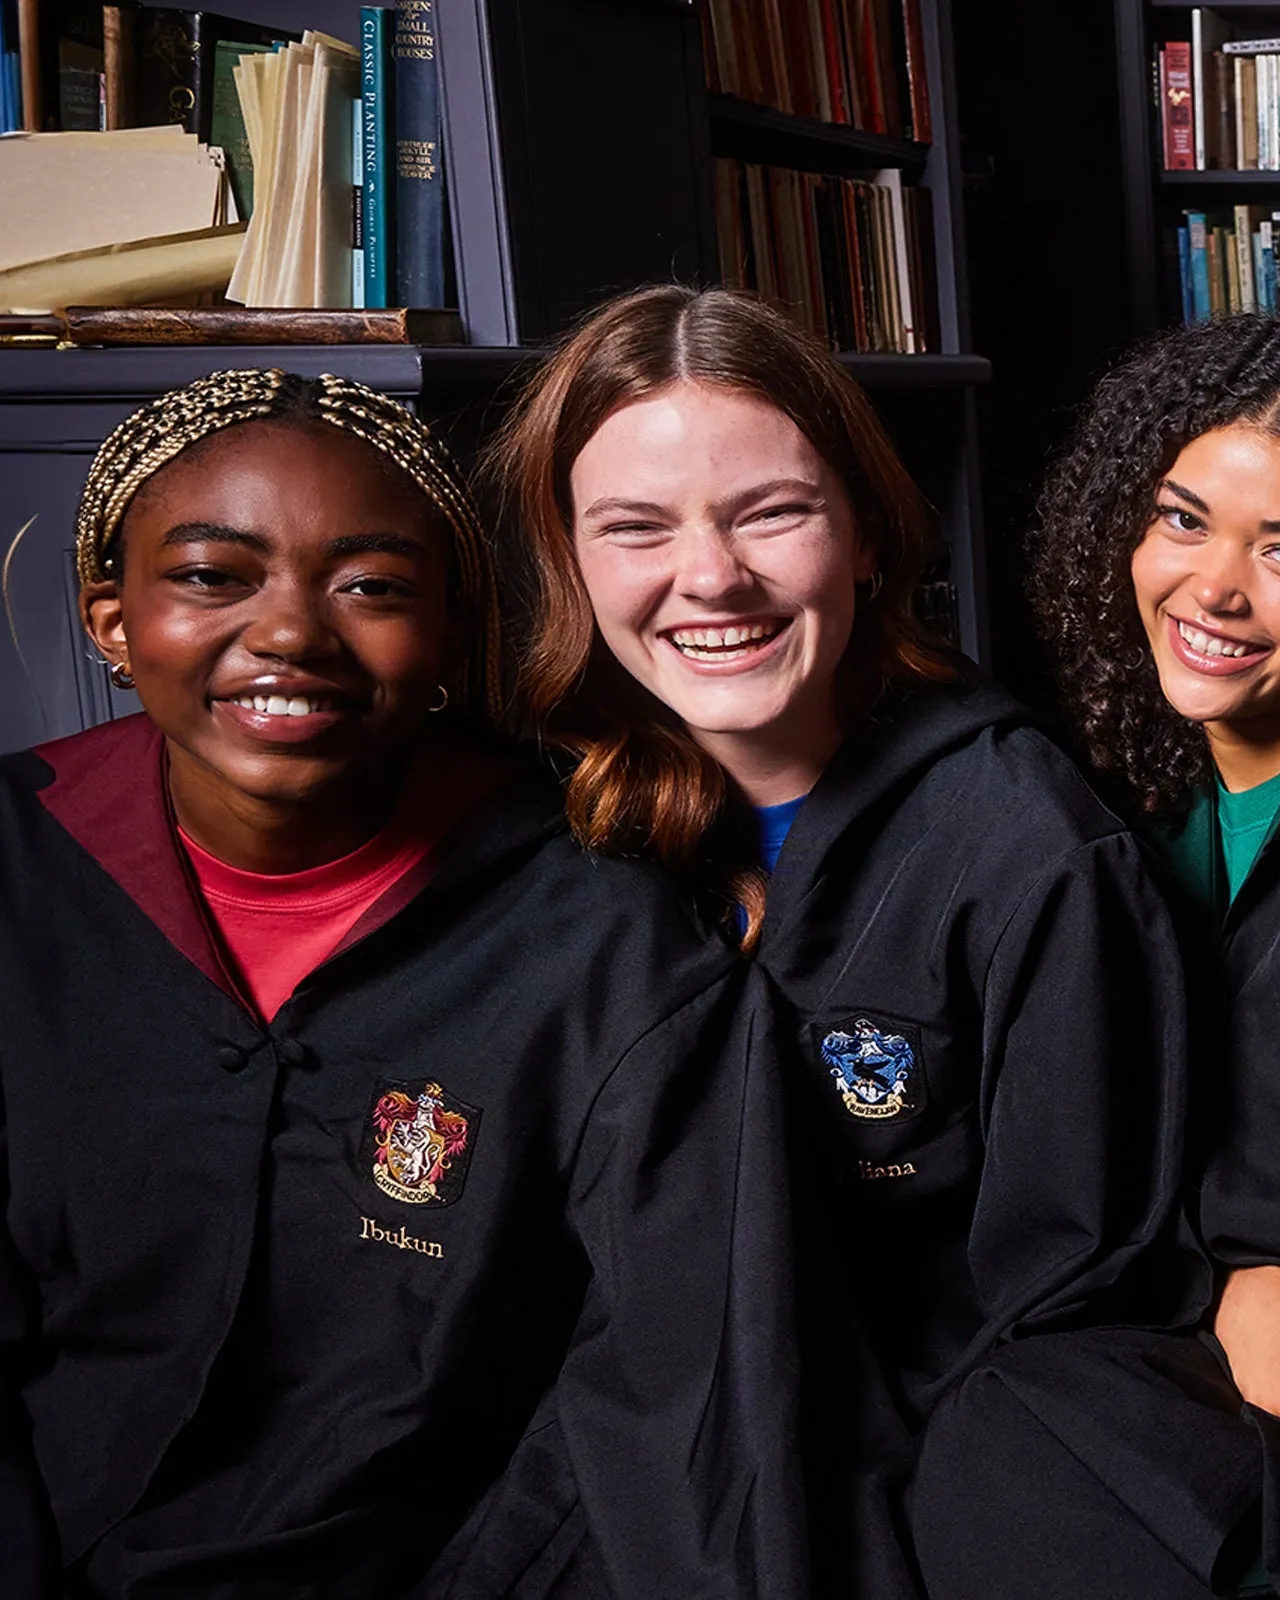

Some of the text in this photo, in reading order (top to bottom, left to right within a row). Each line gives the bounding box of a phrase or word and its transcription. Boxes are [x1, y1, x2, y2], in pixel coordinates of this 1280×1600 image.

[363, 20, 376, 86] CLASSIC
[364, 92, 377, 172] PLANTING
[848, 1103, 898, 1117] RAVENCLAW
[844, 1160, 917, 1181] liana
[358, 1215, 445, 1259] Ibukun
